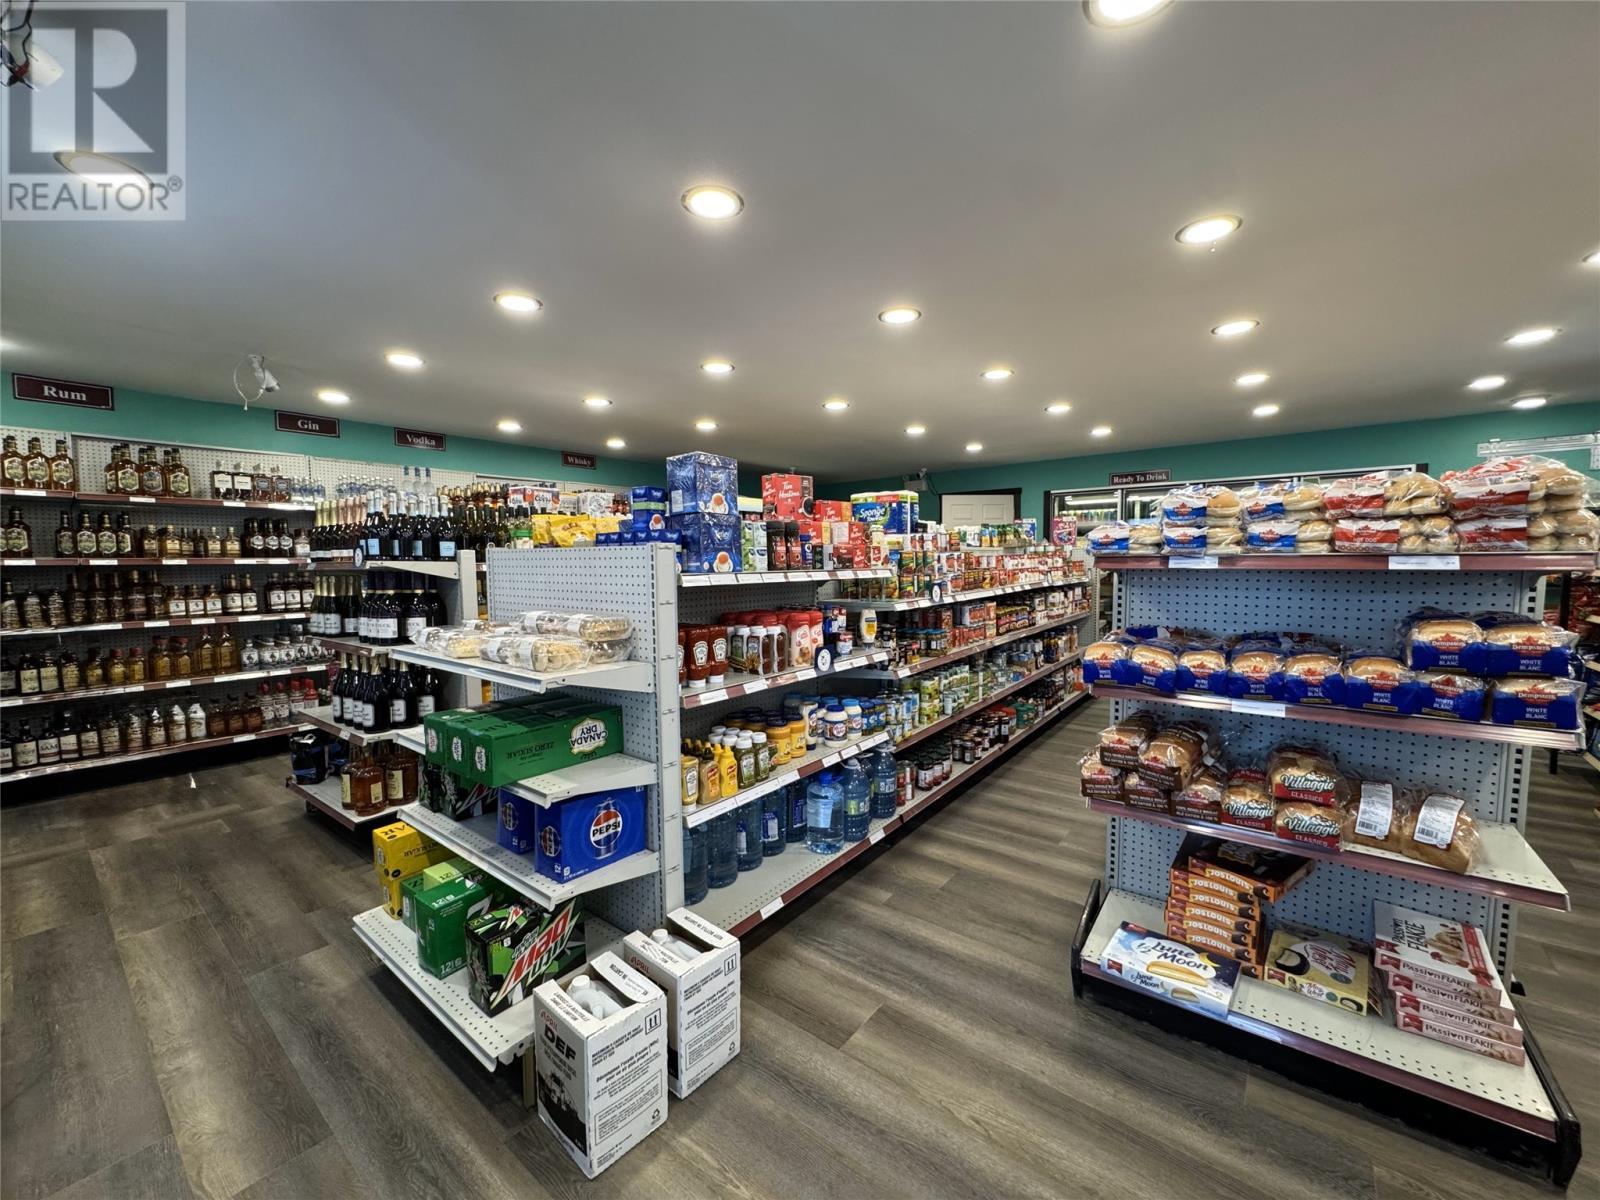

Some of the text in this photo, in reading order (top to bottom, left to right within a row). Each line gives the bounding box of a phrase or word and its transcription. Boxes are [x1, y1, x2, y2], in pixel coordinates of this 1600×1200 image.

[43, 384, 87, 402] Rum
[297, 418, 320, 432] Gin
[406, 433, 437, 447] Vodka
[566, 455, 592, 467] Whisky
[1113, 471, 1167, 485] Ready To Drink
[860, 506, 886, 519] Sponge
[579, 723, 598, 738] DRY
[569, 730, 608, 748] CANADA
[506, 744, 534, 761] SUGAR
[1281, 773, 1336, 793] Villaggio
[1291, 791, 1324, 802] CLASSICO
[1224, 803, 1274, 820] Villaggio
[592, 821, 621, 838] PEPSI
[1236, 819, 1265, 829] CLASSICO
[1283, 816, 1341, 838] Villaggio
[1295, 834, 1328, 847] CLASSICO
[1151, 941, 1195, 959] Lune
[1157, 952, 1209, 972] Moon
[609, 963, 625, 977] CARTON
[1136, 971, 1154, 980] Lune
[1139, 979, 1160, 989] Moon
[545, 1024, 577, 1061] DEF
